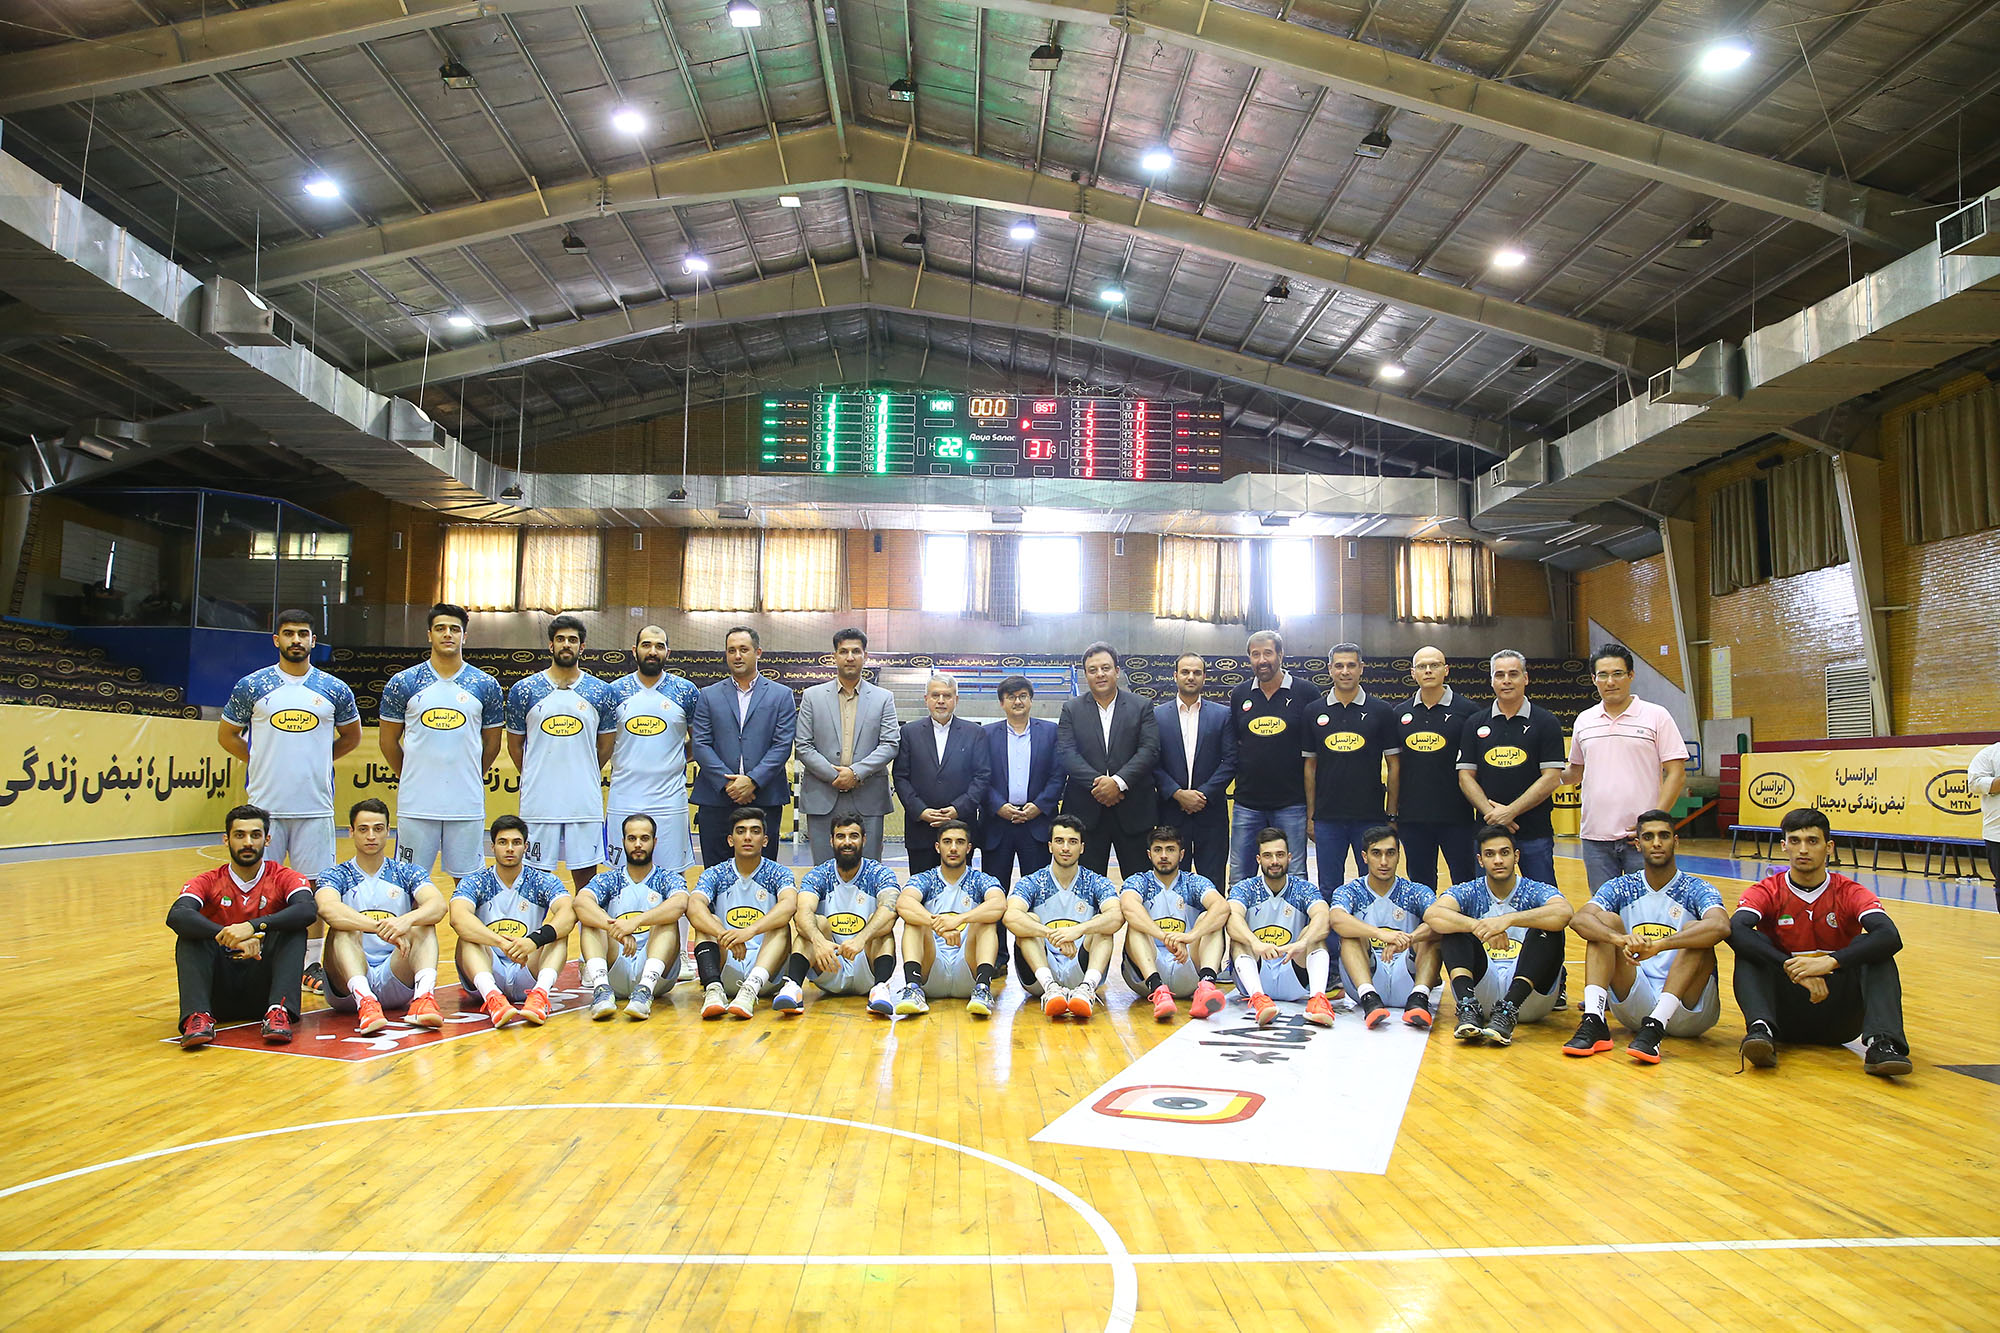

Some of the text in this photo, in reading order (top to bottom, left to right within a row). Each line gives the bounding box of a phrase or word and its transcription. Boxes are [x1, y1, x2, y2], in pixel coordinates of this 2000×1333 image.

[1035, 402, 1056, 412] GST
[1090, 400, 1094, 409] 1
[1138, 402, 1144, 410] 9
[1086, 410, 1094, 419] 2
[1087, 420, 1093, 428] 3
[1086, 430, 1093, 438] 4
[938, 438, 962, 456] 22
[1030, 440, 1050, 458] 31
[1086, 440, 1093, 448] 5
[1050, 446, 1056, 454] G
[1086, 449, 1092, 458] 6
[1088, 458, 1092, 467] 7
[1086, 468, 1092, 477] 8
[278, 712, 312, 724] ایرانسل
[428, 710, 458, 722] ایرانسل
[549, 719, 576, 730] ایرانسل
[632, 719, 660, 730] ایرانسل
[1254, 720, 1280, 729] ایرانسل
[1330, 735, 1359, 746] ایرانسل
[1411, 734, 1440, 745] ایرانسل
[1491, 749, 1520, 760] ایرانسل
[0, 746, 231, 806] ایرانسل؛ نبض زندگی
[1836, 768, 1877, 787] ایرانسل؛
[1756, 780, 1786, 796] ایرانسل
[1556, 792, 1580, 802] MTN
[1811, 794, 1905, 815] نبض زندگی دیجیتال
[1950, 800, 1972, 810] MTN
[732, 910, 758, 921] ایرانسل
[832, 916, 858, 927] ایرانسل
